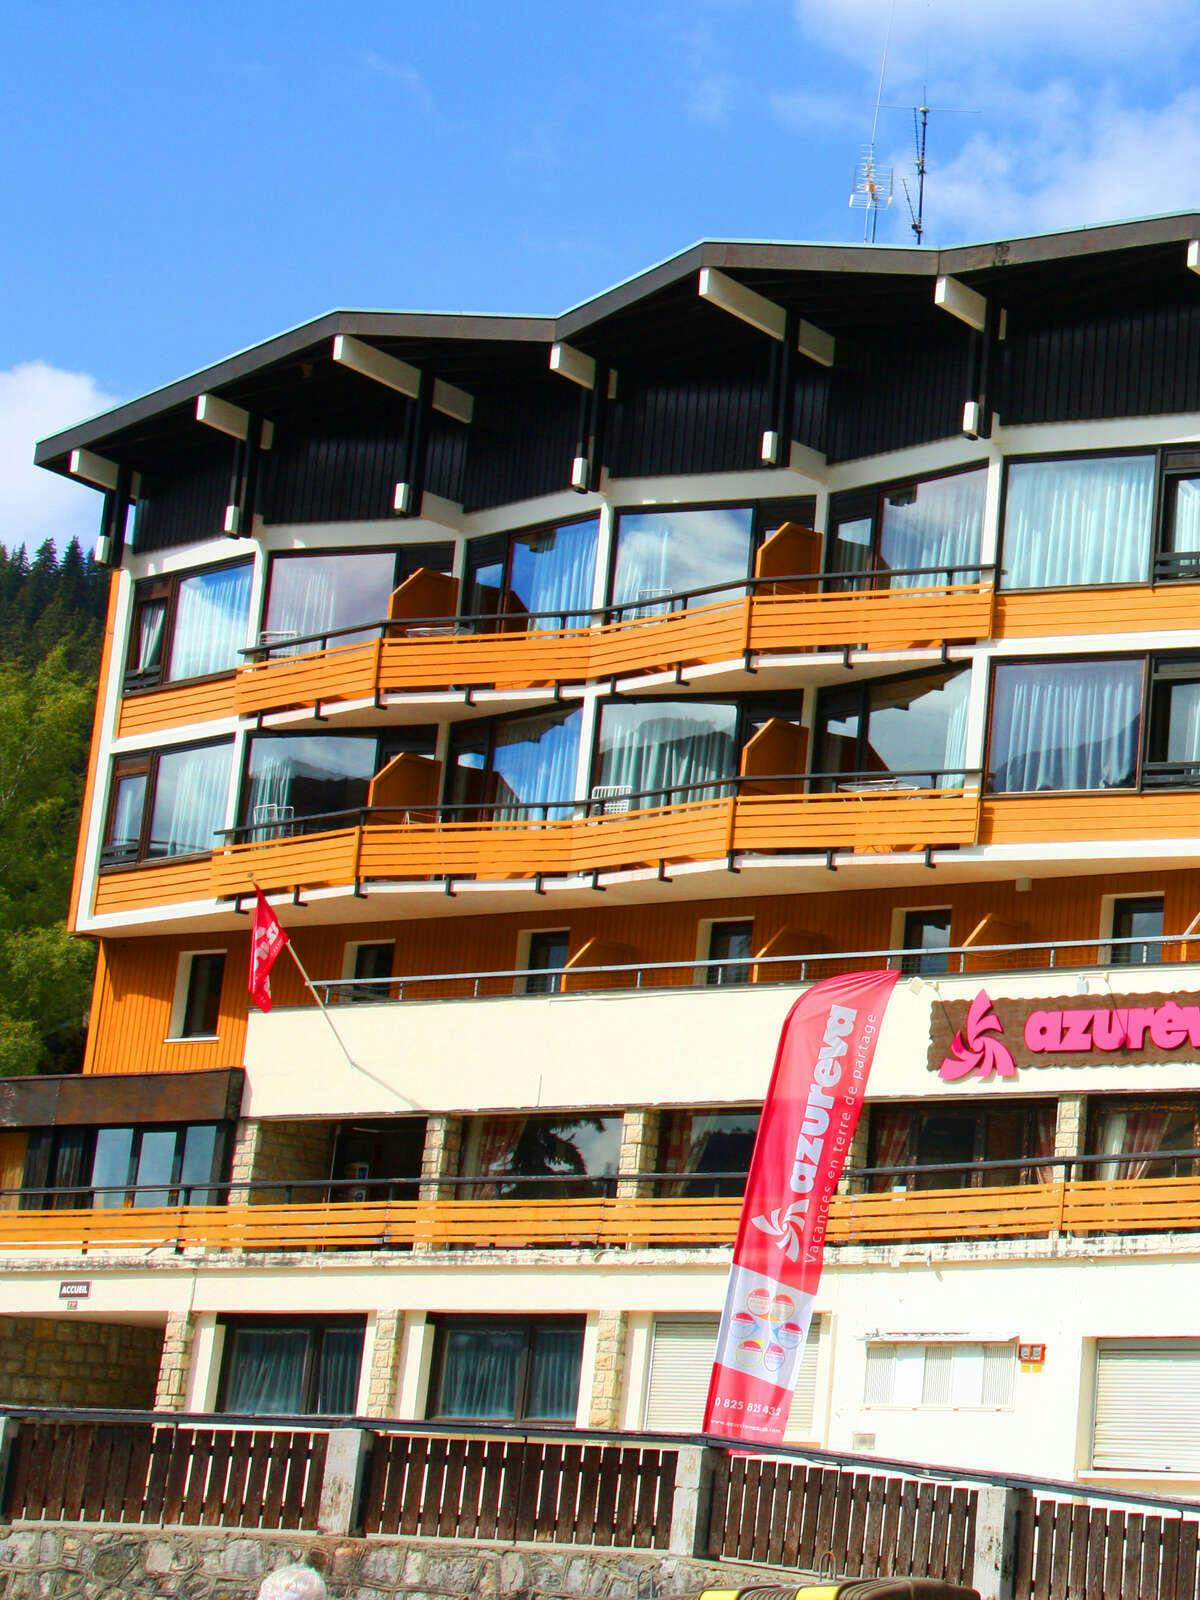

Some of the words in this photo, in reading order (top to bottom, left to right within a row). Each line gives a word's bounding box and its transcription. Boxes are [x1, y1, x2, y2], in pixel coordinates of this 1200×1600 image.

[853, 1014, 876, 1080] partage
[790, 1004, 858, 1193] azureva
[844, 1086, 858, 1105] de
[833, 1112, 850, 1152] terre
[828, 1160, 839, 1179] en
[804, 1185, 832, 1263] Vacances
[61, 1285, 88, 1294] ACCUEIL
[723, 1398, 745, 1410] 825
